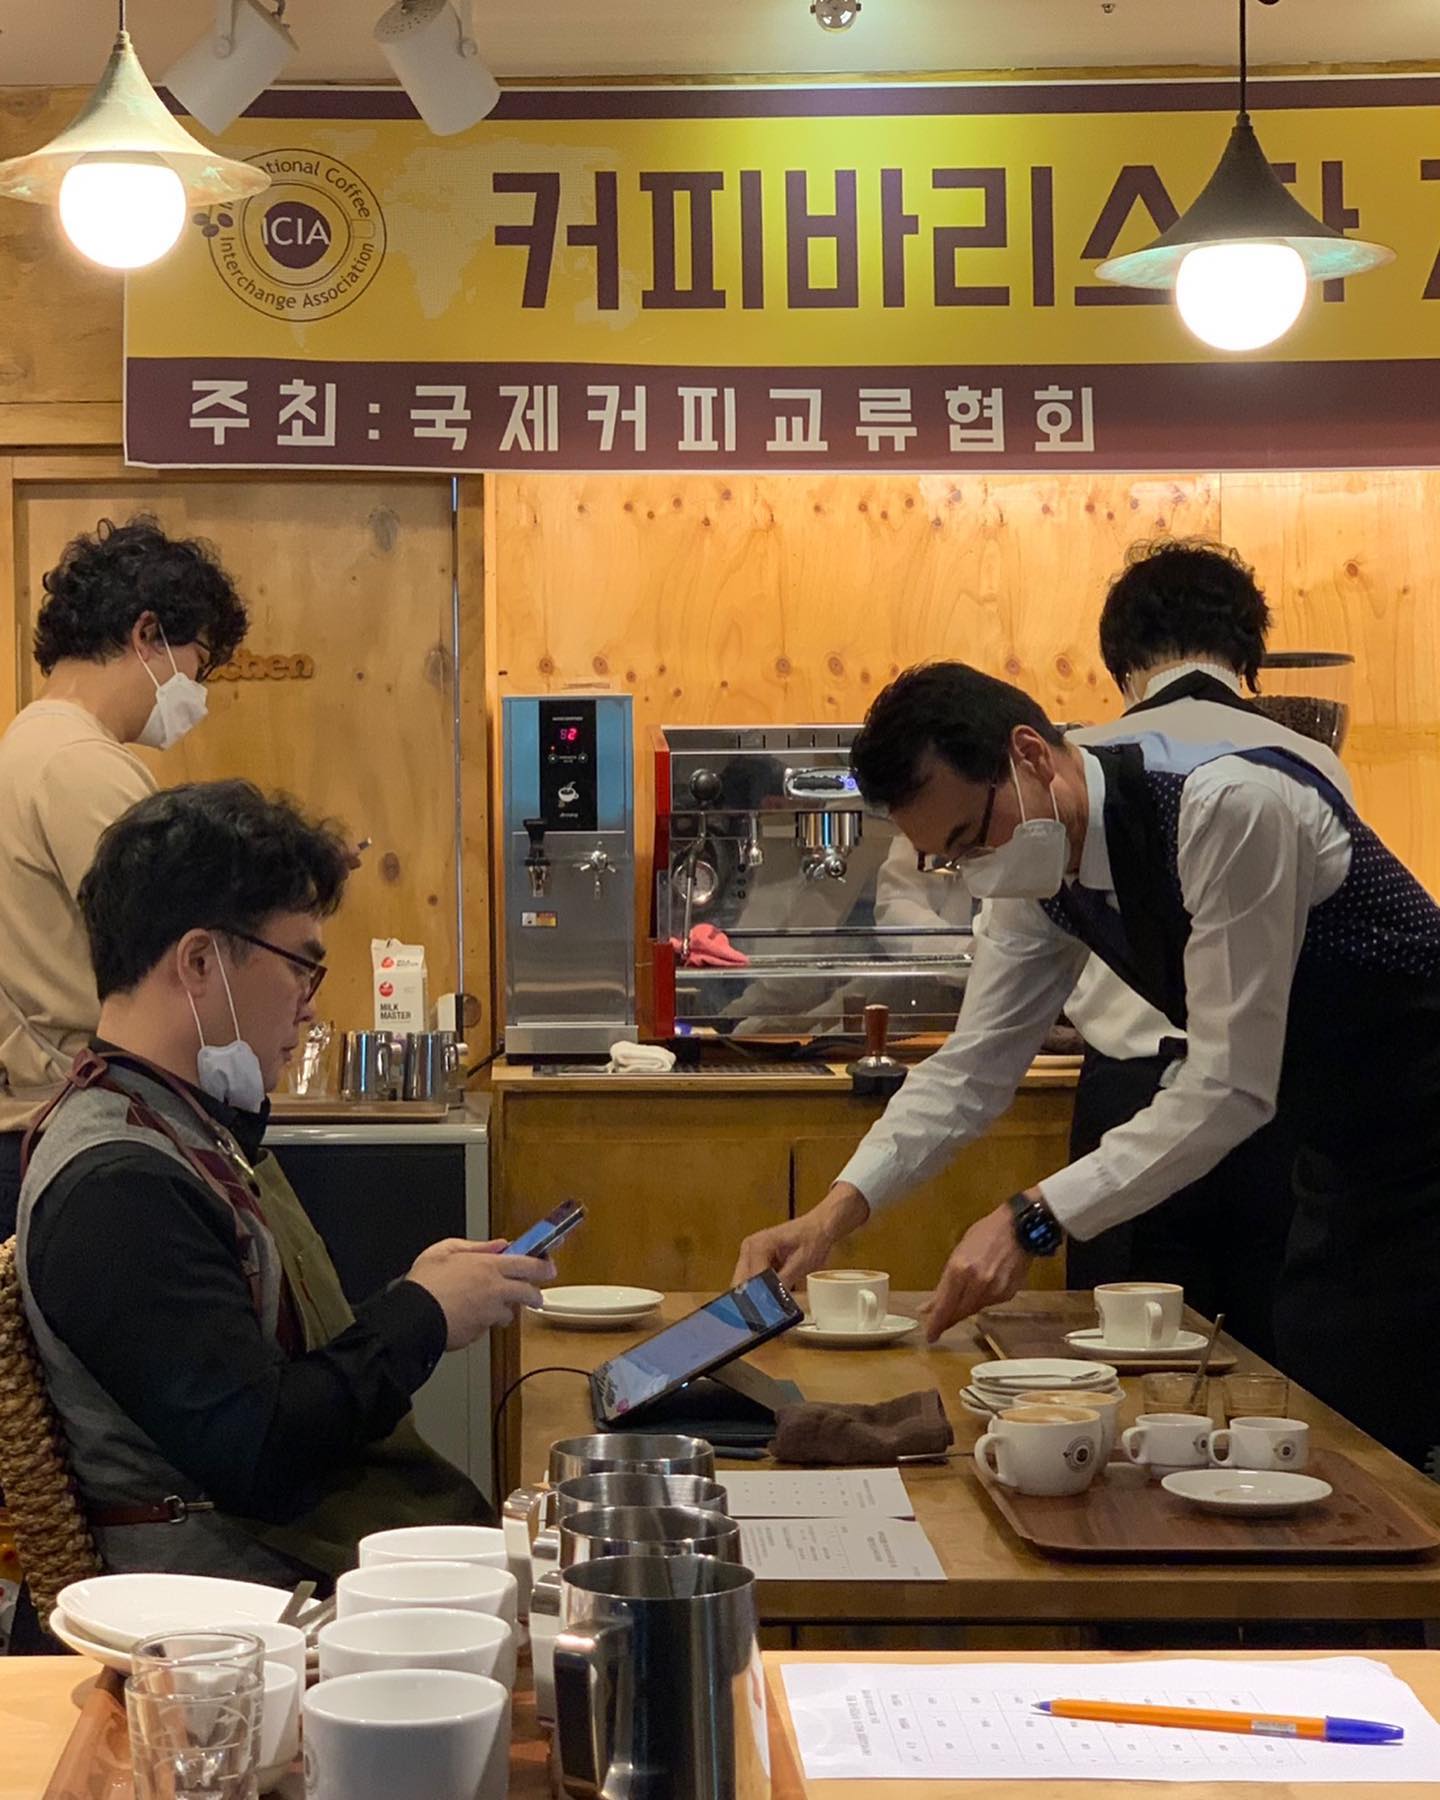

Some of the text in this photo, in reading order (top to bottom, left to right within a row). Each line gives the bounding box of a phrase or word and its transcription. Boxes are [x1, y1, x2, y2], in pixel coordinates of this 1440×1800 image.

[325, 167, 371, 219] Coffee
[263, 216, 331, 246] ICIA
[220, 236, 375, 311] Interchange Association
[380, 1003, 399, 1011] MILK
[380, 1011, 412, 1020] MASTER
